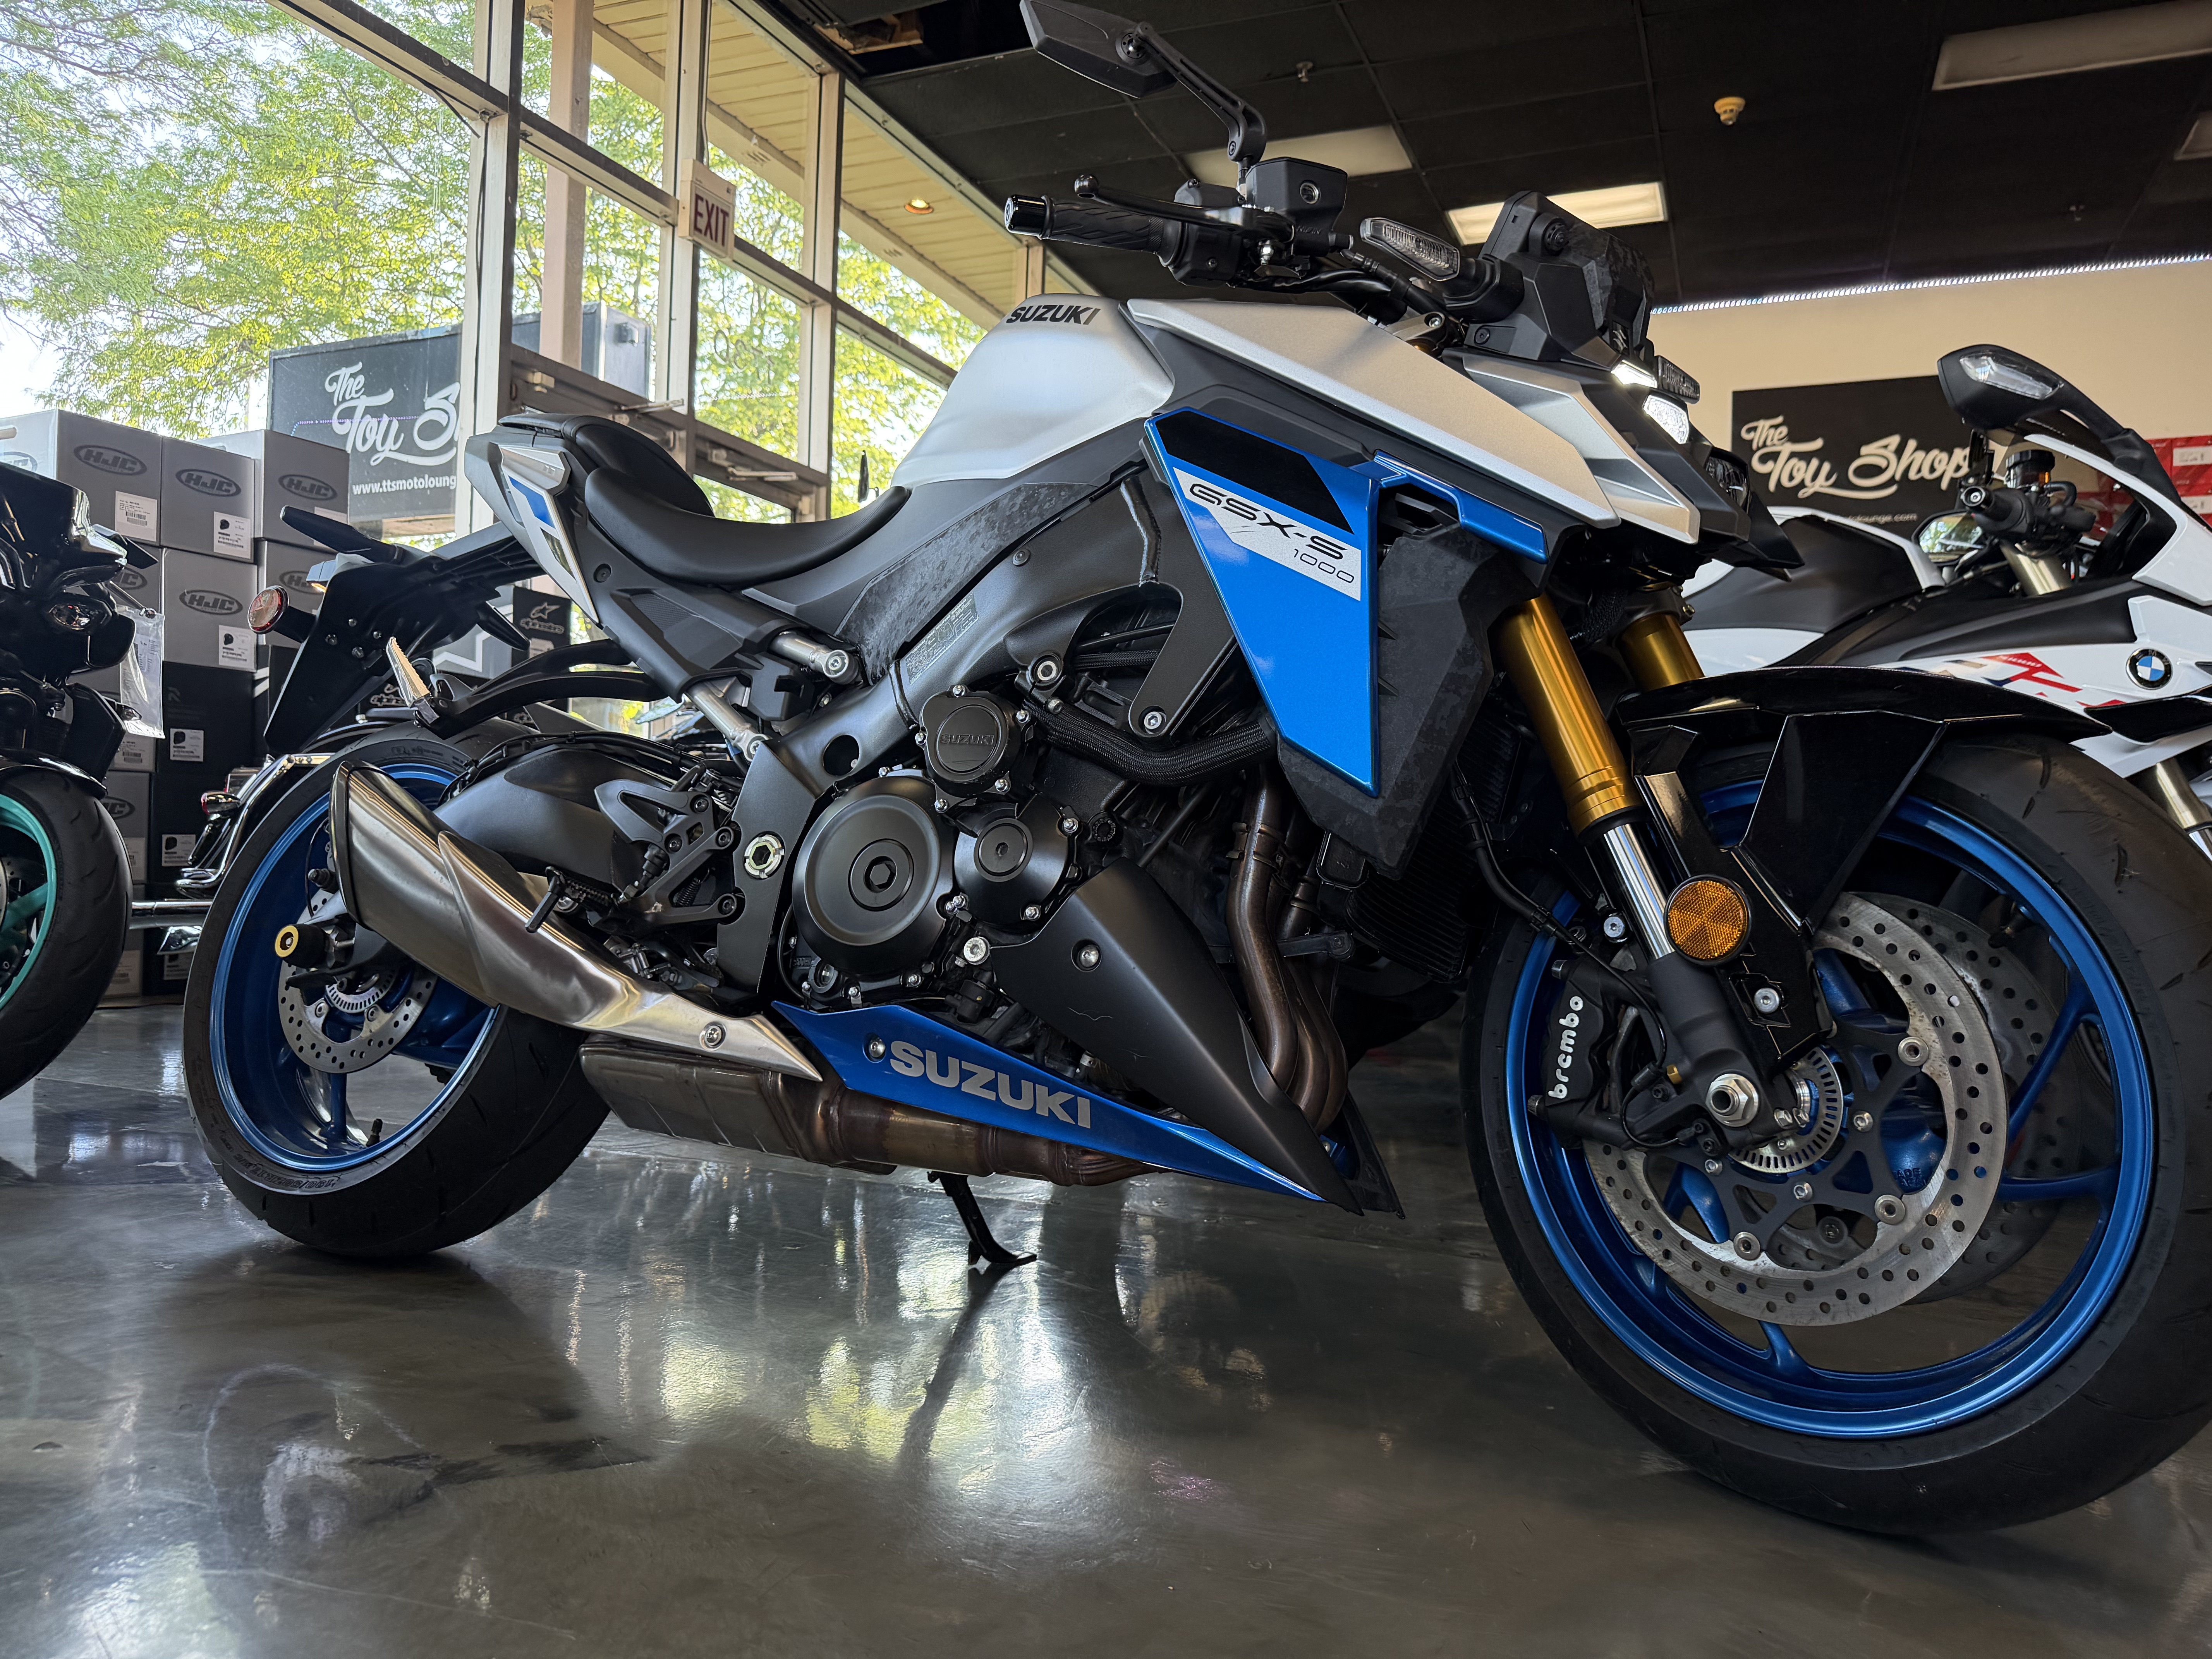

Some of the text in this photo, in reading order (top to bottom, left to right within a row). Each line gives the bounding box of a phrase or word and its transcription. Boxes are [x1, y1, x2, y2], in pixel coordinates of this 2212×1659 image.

[694, 193, 729, 247] EXIT
[1006, 304, 1101, 325] SUZUKI
[325, 361, 365, 406] The
[1741, 415, 1788, 451] The
[83, 448, 138, 472] HJC
[1848, 433, 1970, 491] Shop
[184, 472, 233, 493] HJC
[286, 477, 330, 497] HJC
[1189, 483, 1348, 560] GSX-S
[1293, 548, 1355, 583] 1000
[188, 594, 235, 611] HJC
[940, 733, 994, 745] SUZUKI
[1548, 996, 1583, 1099] brembo
[890, 1040, 1091, 1129] SUZUKI
